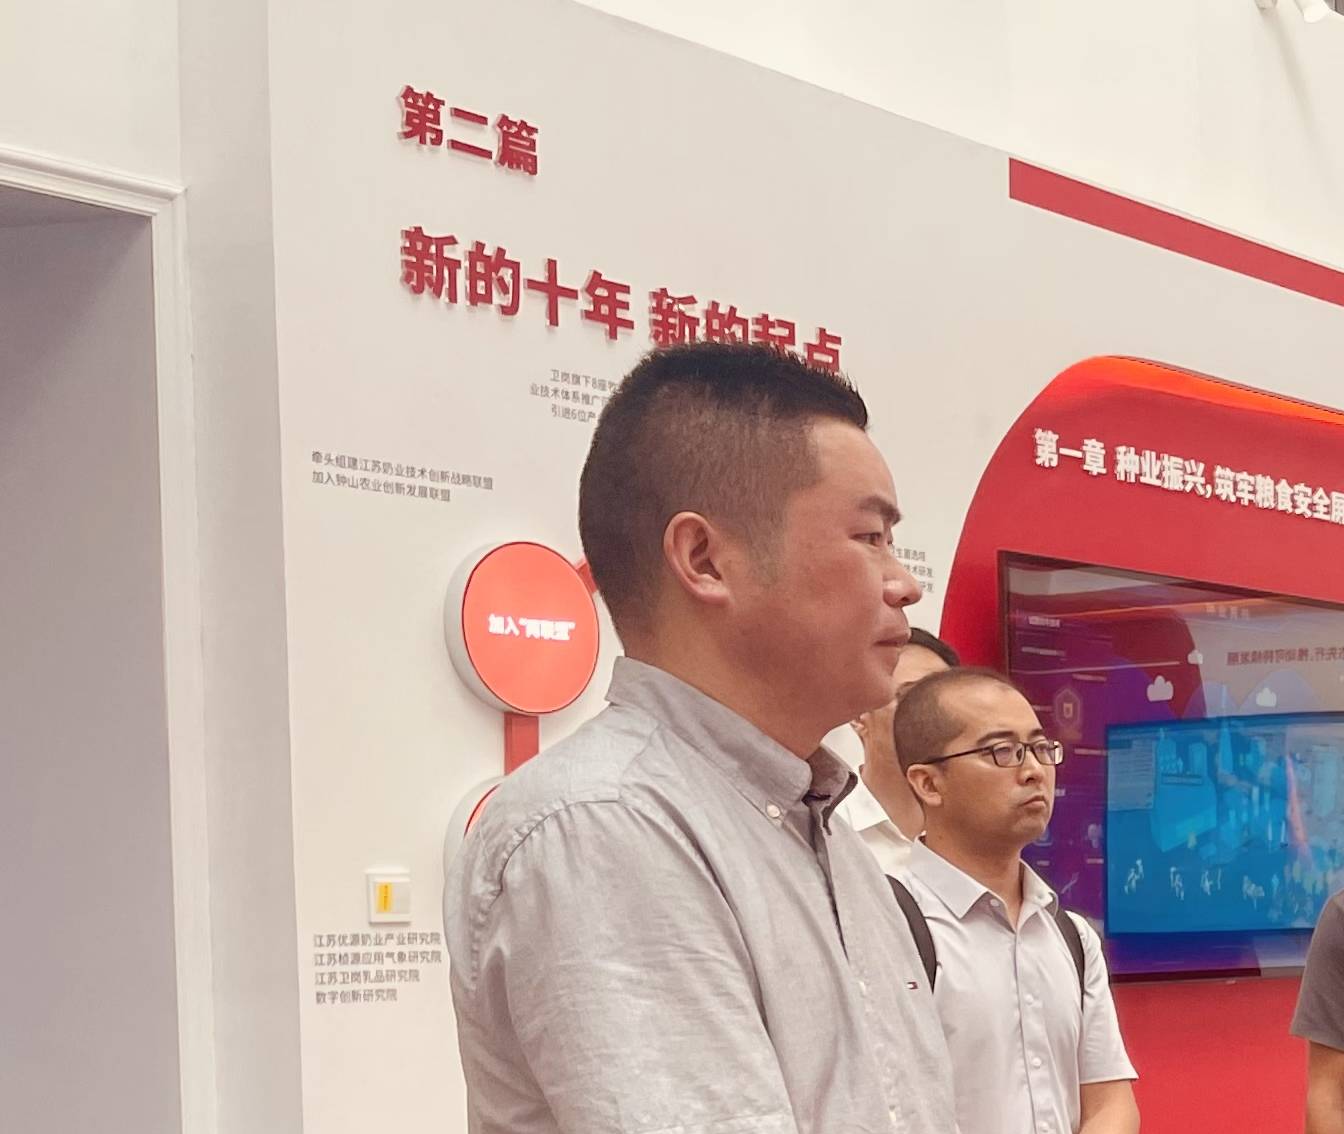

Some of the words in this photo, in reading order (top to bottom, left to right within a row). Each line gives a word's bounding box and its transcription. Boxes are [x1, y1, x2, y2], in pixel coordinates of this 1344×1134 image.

[396, 84, 540, 176] 第二篇
[399, 225, 636, 341] 新的十年
[1033, 427, 1107, 477] 第一章
